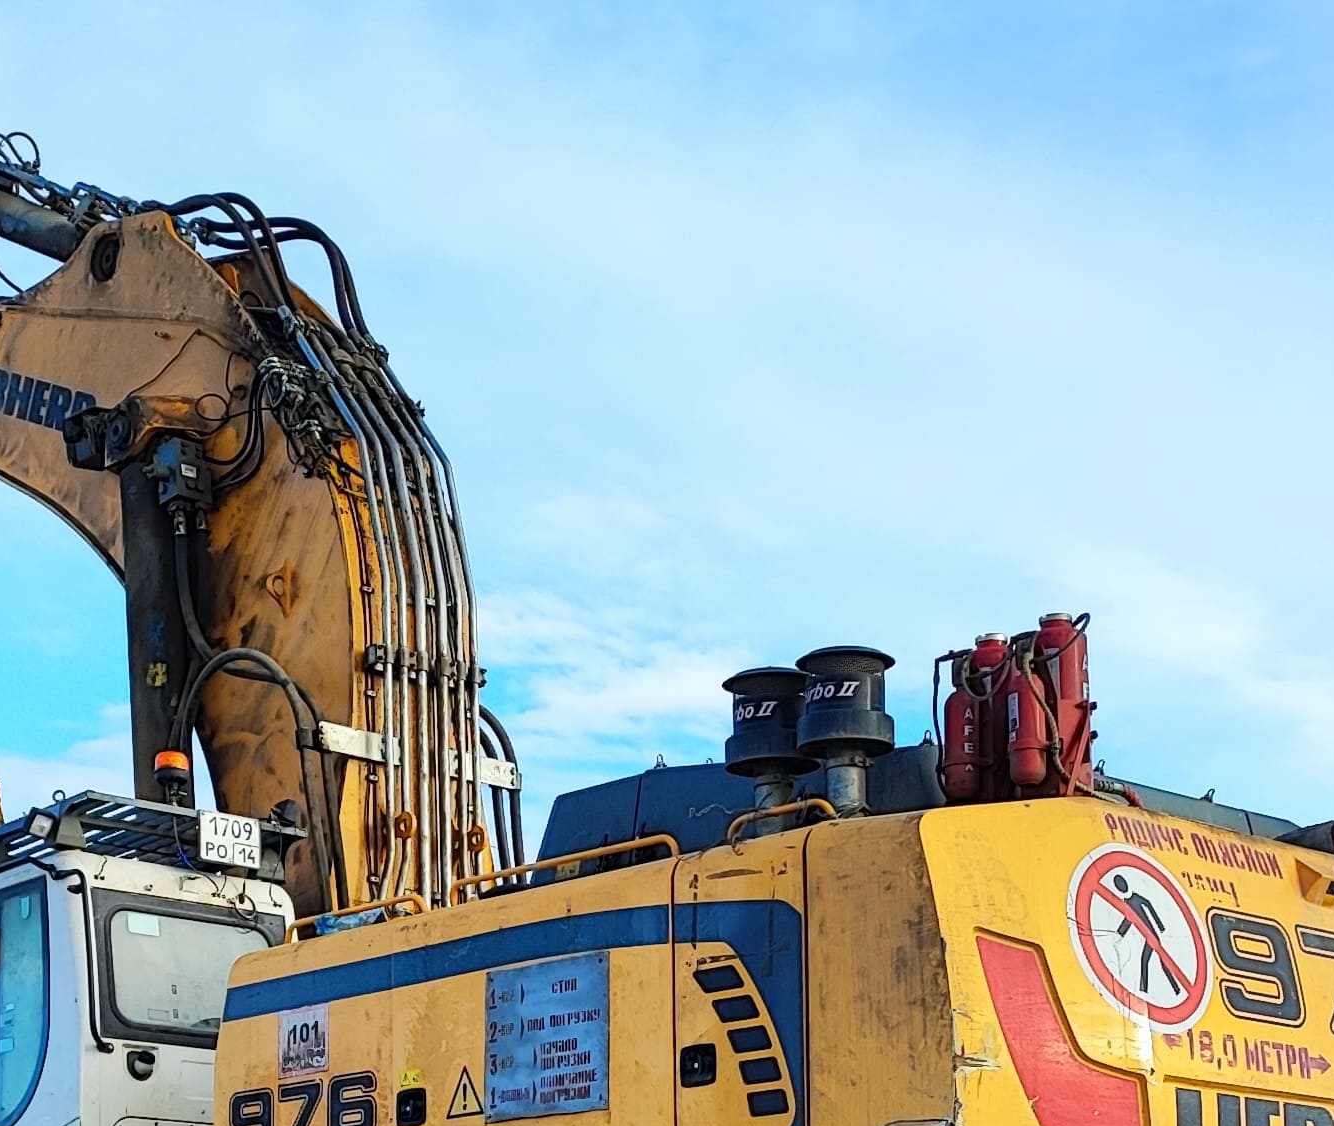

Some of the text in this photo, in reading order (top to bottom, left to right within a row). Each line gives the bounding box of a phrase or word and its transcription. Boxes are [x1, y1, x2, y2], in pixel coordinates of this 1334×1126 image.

[208, 816, 253, 841] 1709
[238, 847, 255, 865] 14
[289, 1020, 320, 1046] 101
[1244, 1037, 1312, 1080] МЕТРА
